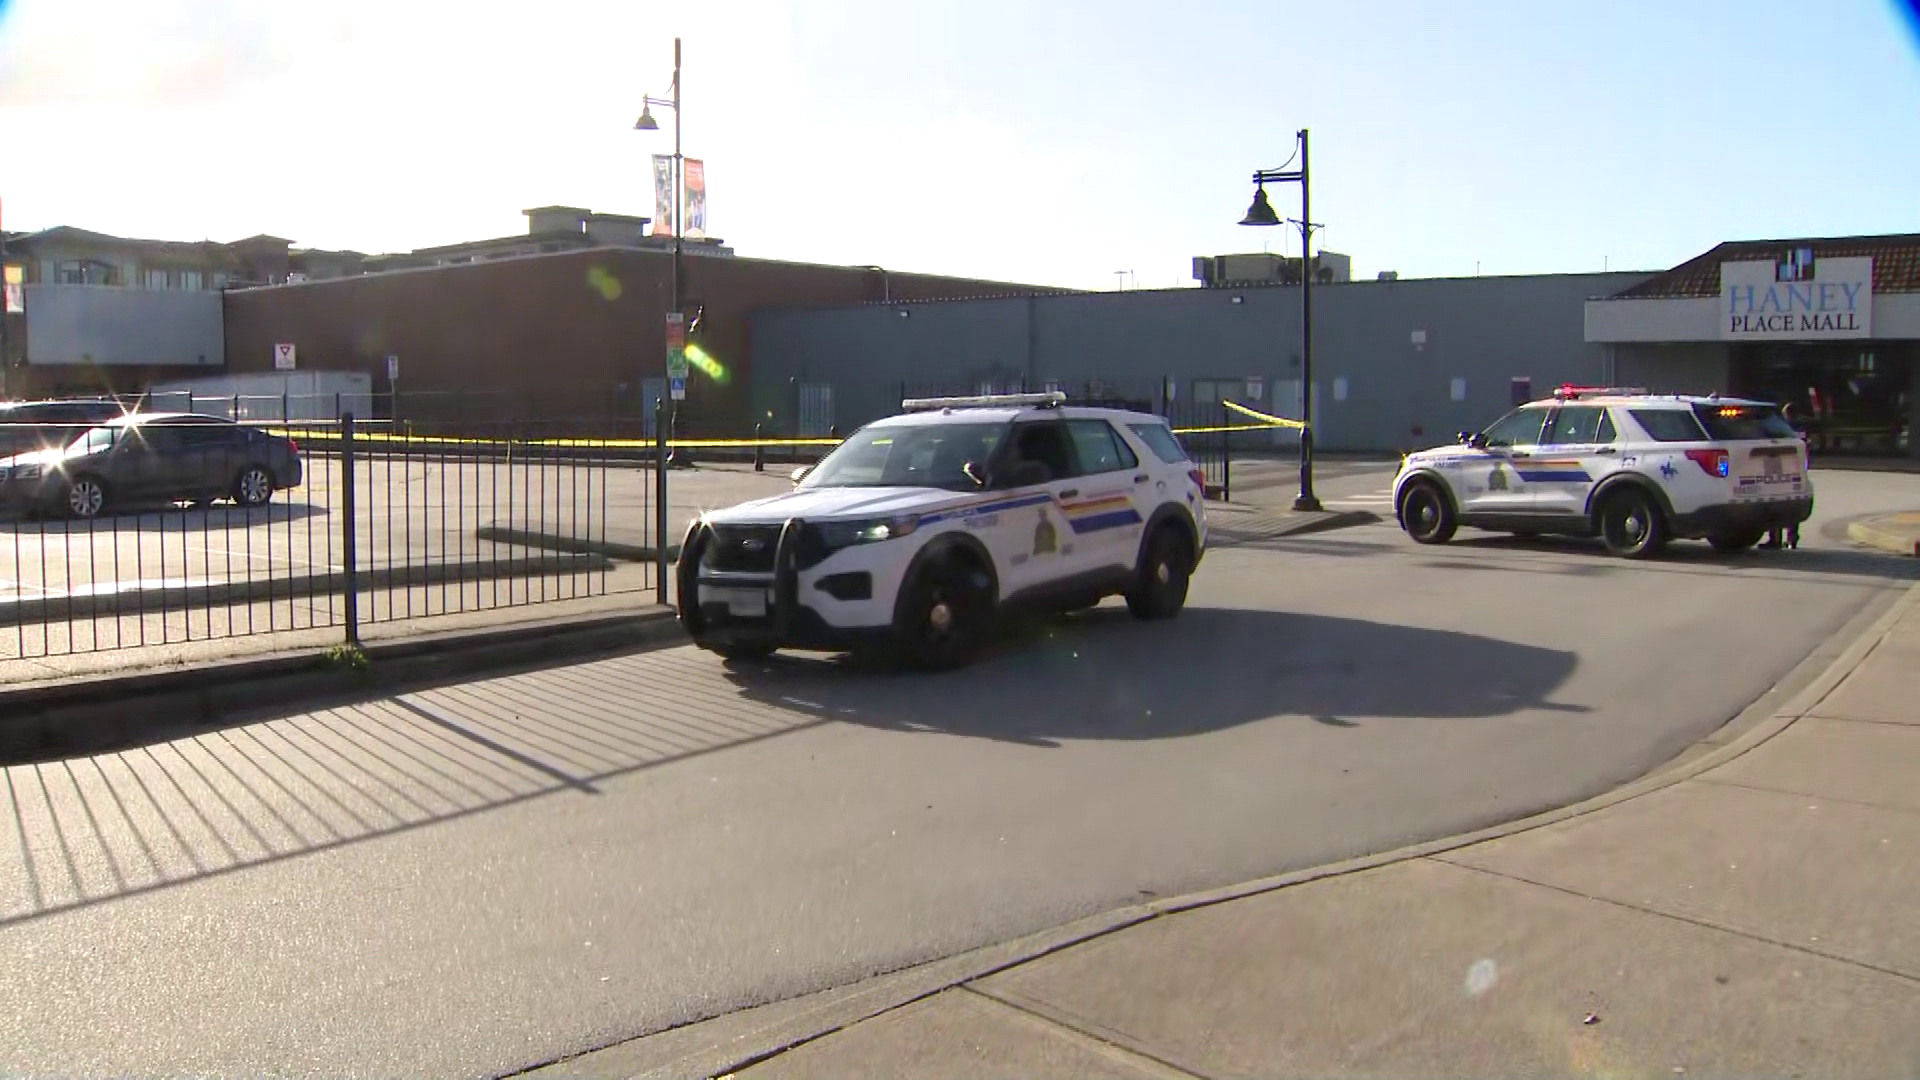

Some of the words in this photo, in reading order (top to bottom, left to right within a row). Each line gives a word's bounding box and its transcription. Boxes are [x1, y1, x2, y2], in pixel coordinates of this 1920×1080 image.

[1730, 283, 1862, 313] HANEY
[1731, 314, 1794, 332] PLACE
[1800, 313, 1860, 331] MALL
[1755, 474, 1792, 485] POLICE
